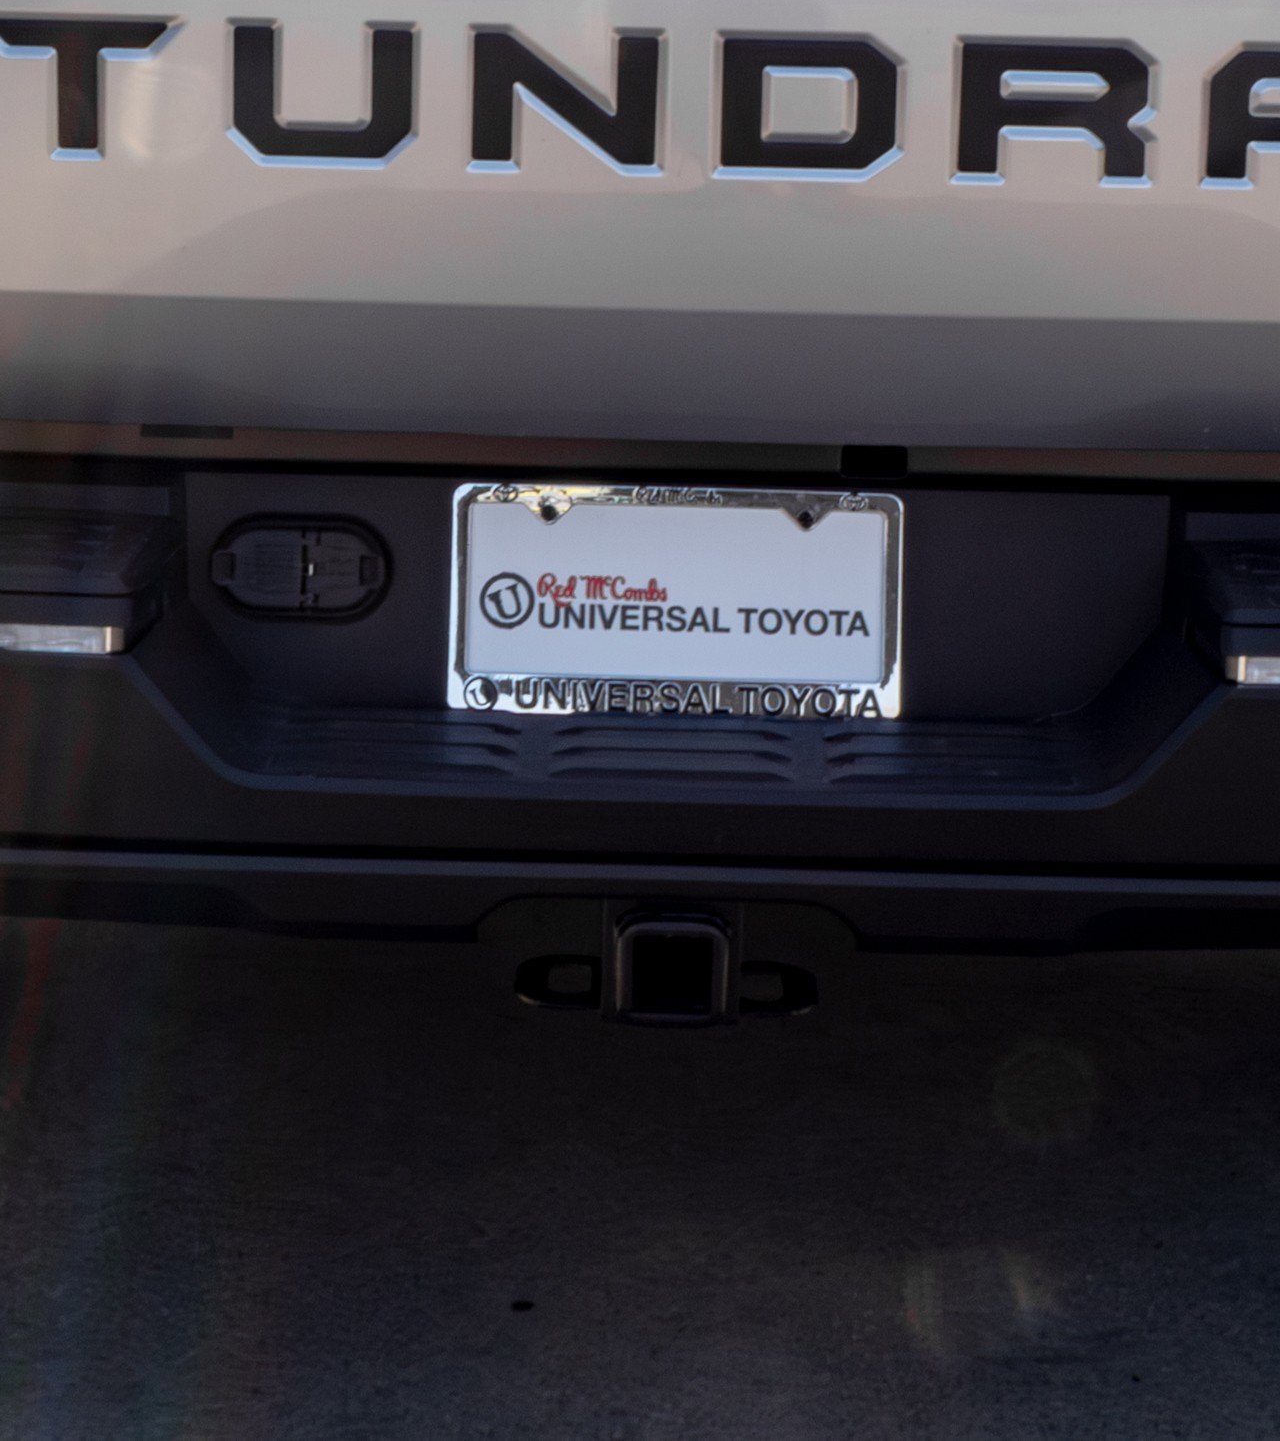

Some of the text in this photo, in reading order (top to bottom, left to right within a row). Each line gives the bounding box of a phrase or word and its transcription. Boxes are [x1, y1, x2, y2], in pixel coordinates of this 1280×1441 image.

[537, 573, 668, 607] Red McCombs
[538, 603, 870, 637] UNIVERSAL TOYOTA
[517, 678, 730, 714] UNIVERSAL
[737, 684, 883, 719] TOYOTA
